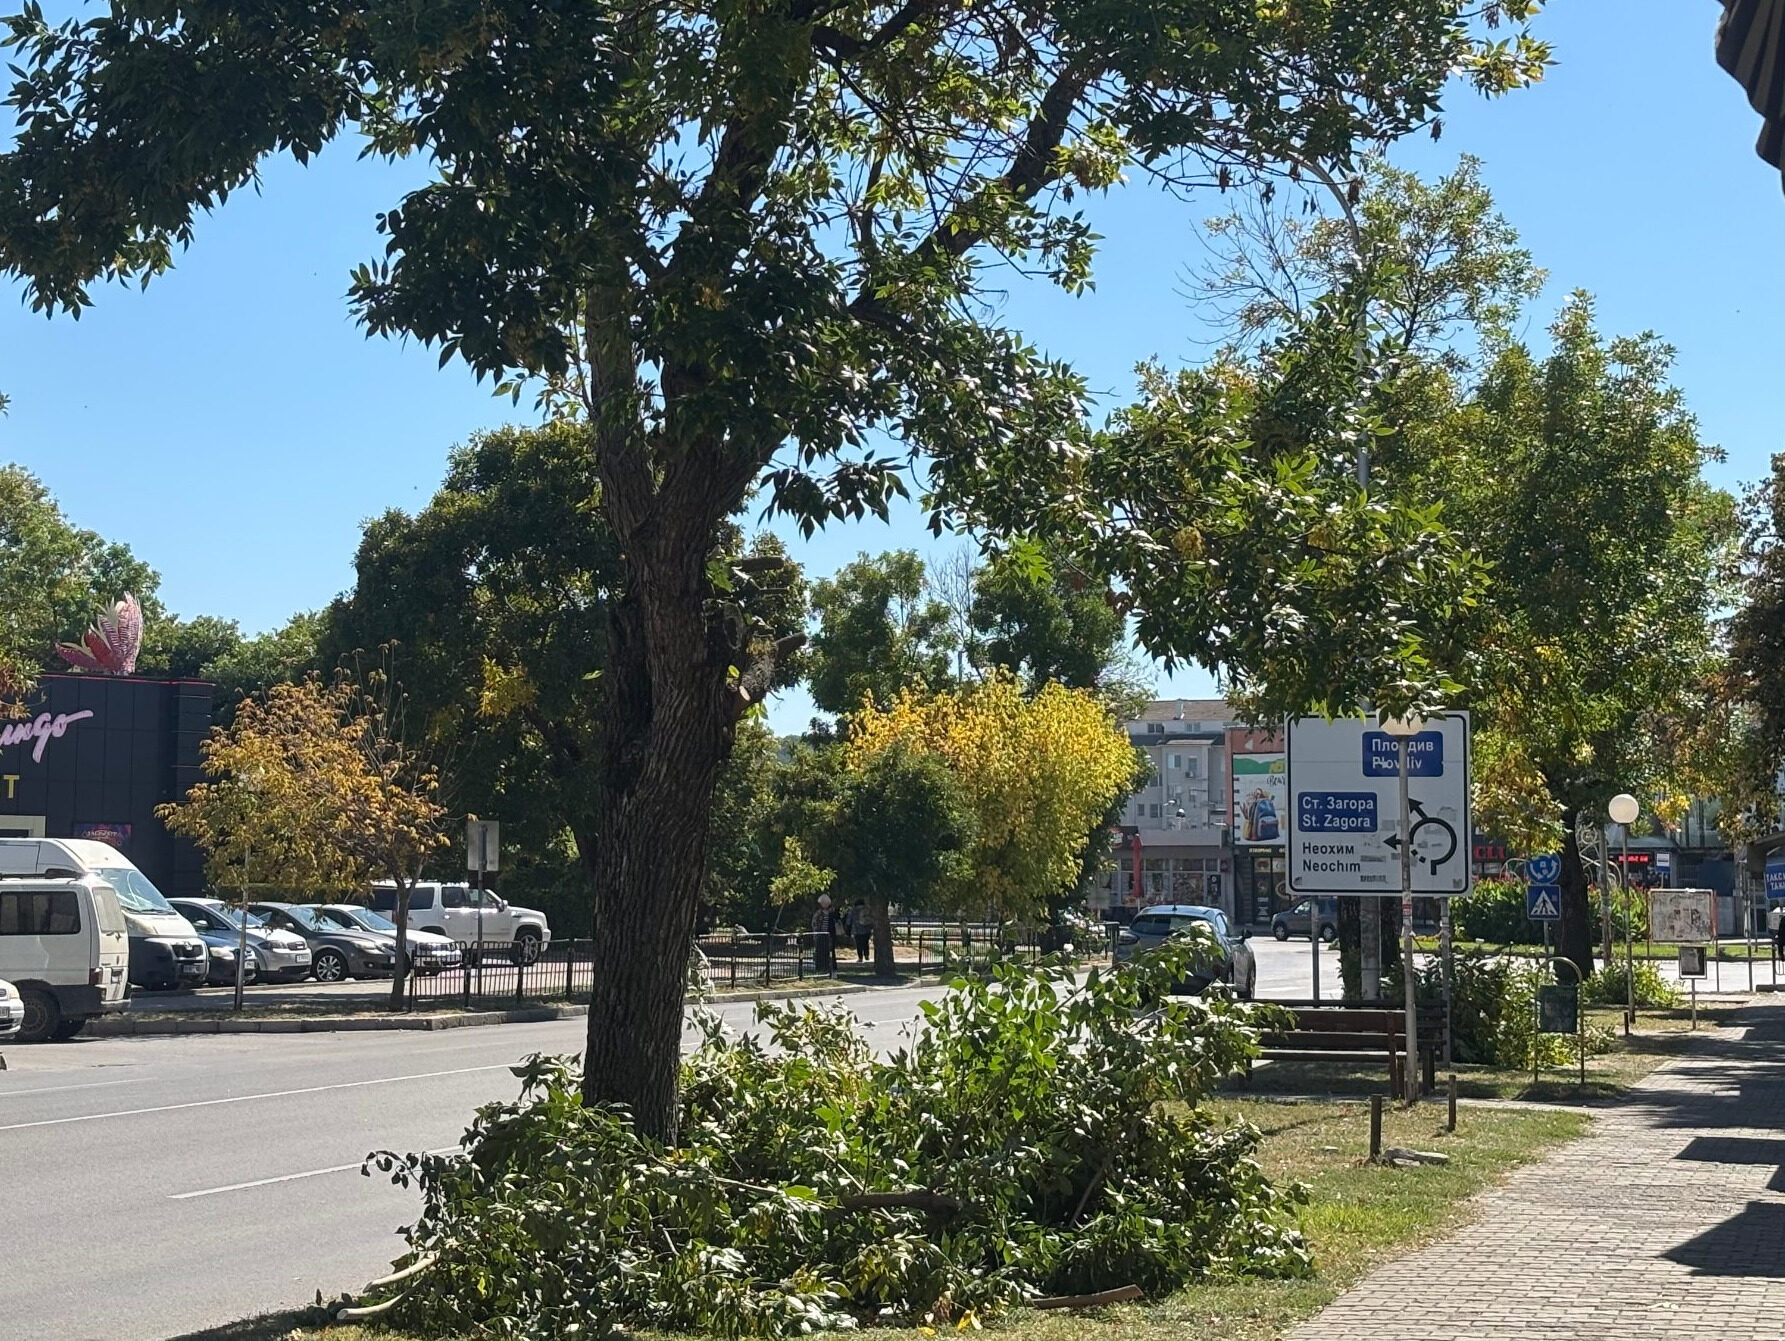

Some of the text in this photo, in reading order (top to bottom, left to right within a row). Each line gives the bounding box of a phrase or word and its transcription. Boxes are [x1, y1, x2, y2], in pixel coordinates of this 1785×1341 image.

[1372, 738, 1434, 753] Плодив
[1372, 756, 1422, 769] Ploviv
[1302, 796, 1374, 812] Ст. Загора
[1302, 814, 1371, 830] St. Zagora
[1302, 841, 1355, 855] Неохим
[1302, 859, 1361, 873] Neochim
